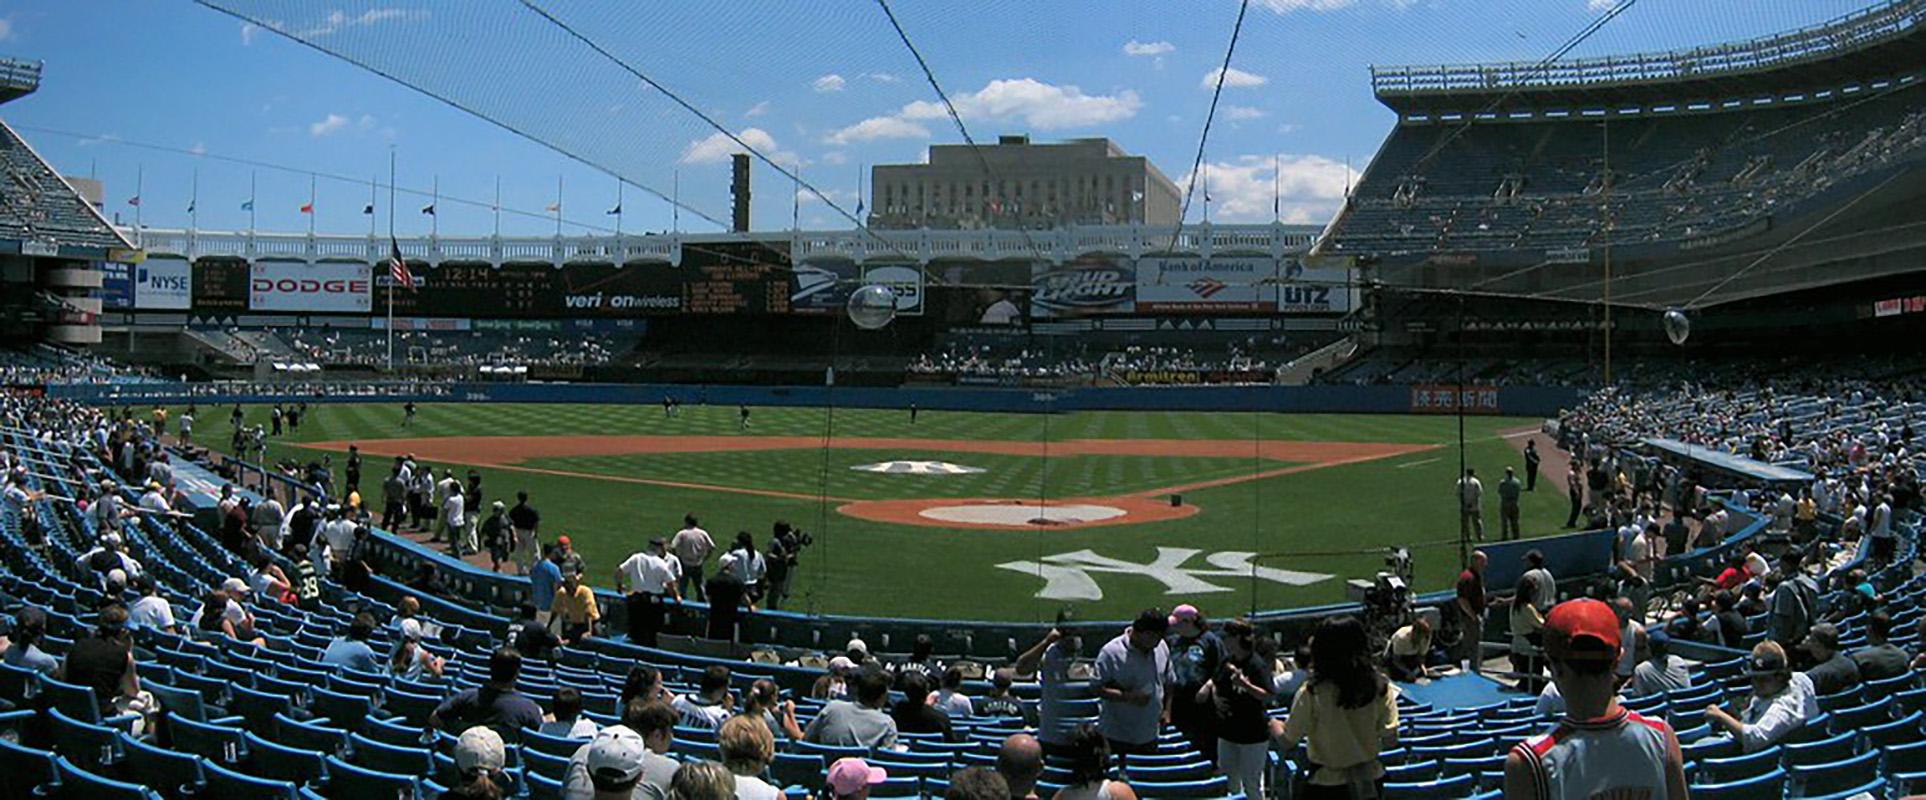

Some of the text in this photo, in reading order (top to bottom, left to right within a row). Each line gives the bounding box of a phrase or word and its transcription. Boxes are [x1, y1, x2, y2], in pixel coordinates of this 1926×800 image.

[1159, 261, 1187, 272] Bank
[1204, 261, 1253, 272] America
[445, 268, 489, 280] 12:14
[152, 276, 187, 290] NYSE
[253, 279, 368, 293] DODGE
[1034, 282, 1129, 300] LIGHT
[1284, 287, 1329, 304] UTZ
